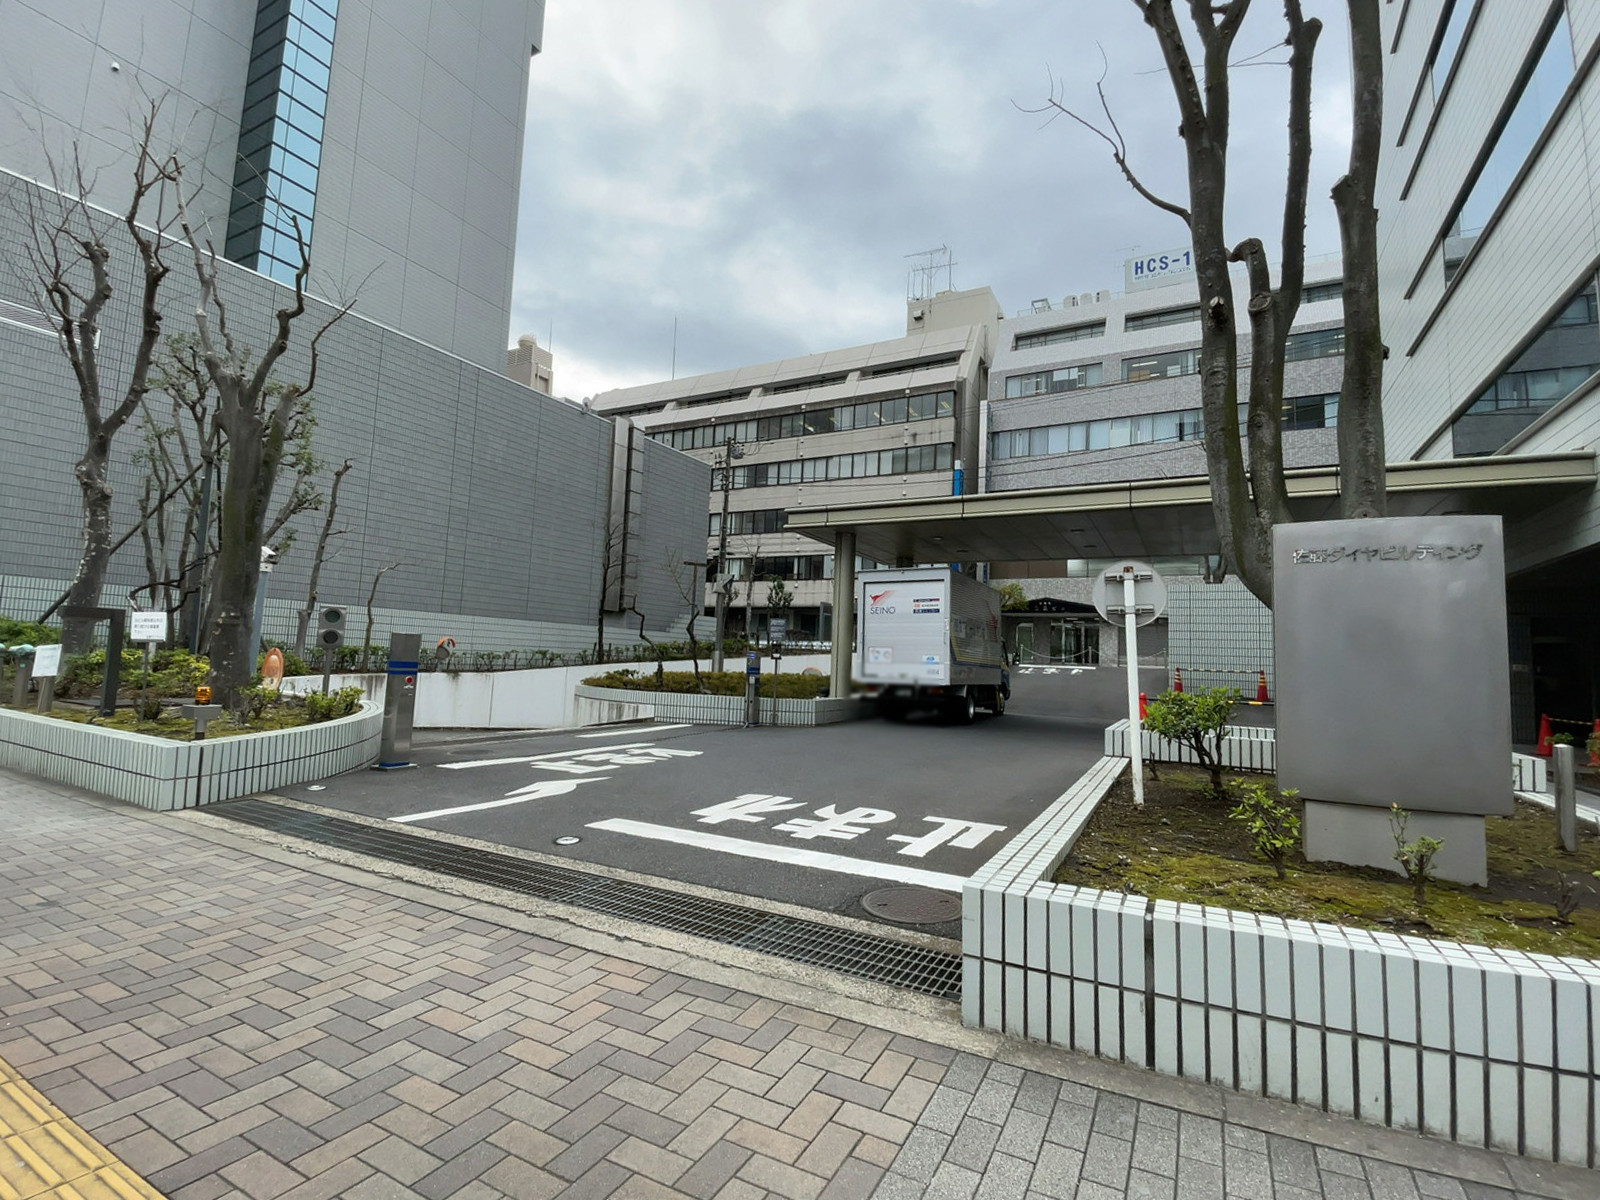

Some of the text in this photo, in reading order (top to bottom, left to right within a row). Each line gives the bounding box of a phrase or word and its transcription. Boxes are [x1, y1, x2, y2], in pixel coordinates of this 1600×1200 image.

[1134, 250, 1190, 276] HCS-1
[870, 606, 896, 615] SEINO
[690, 794, 1008, 857] 止まれ
